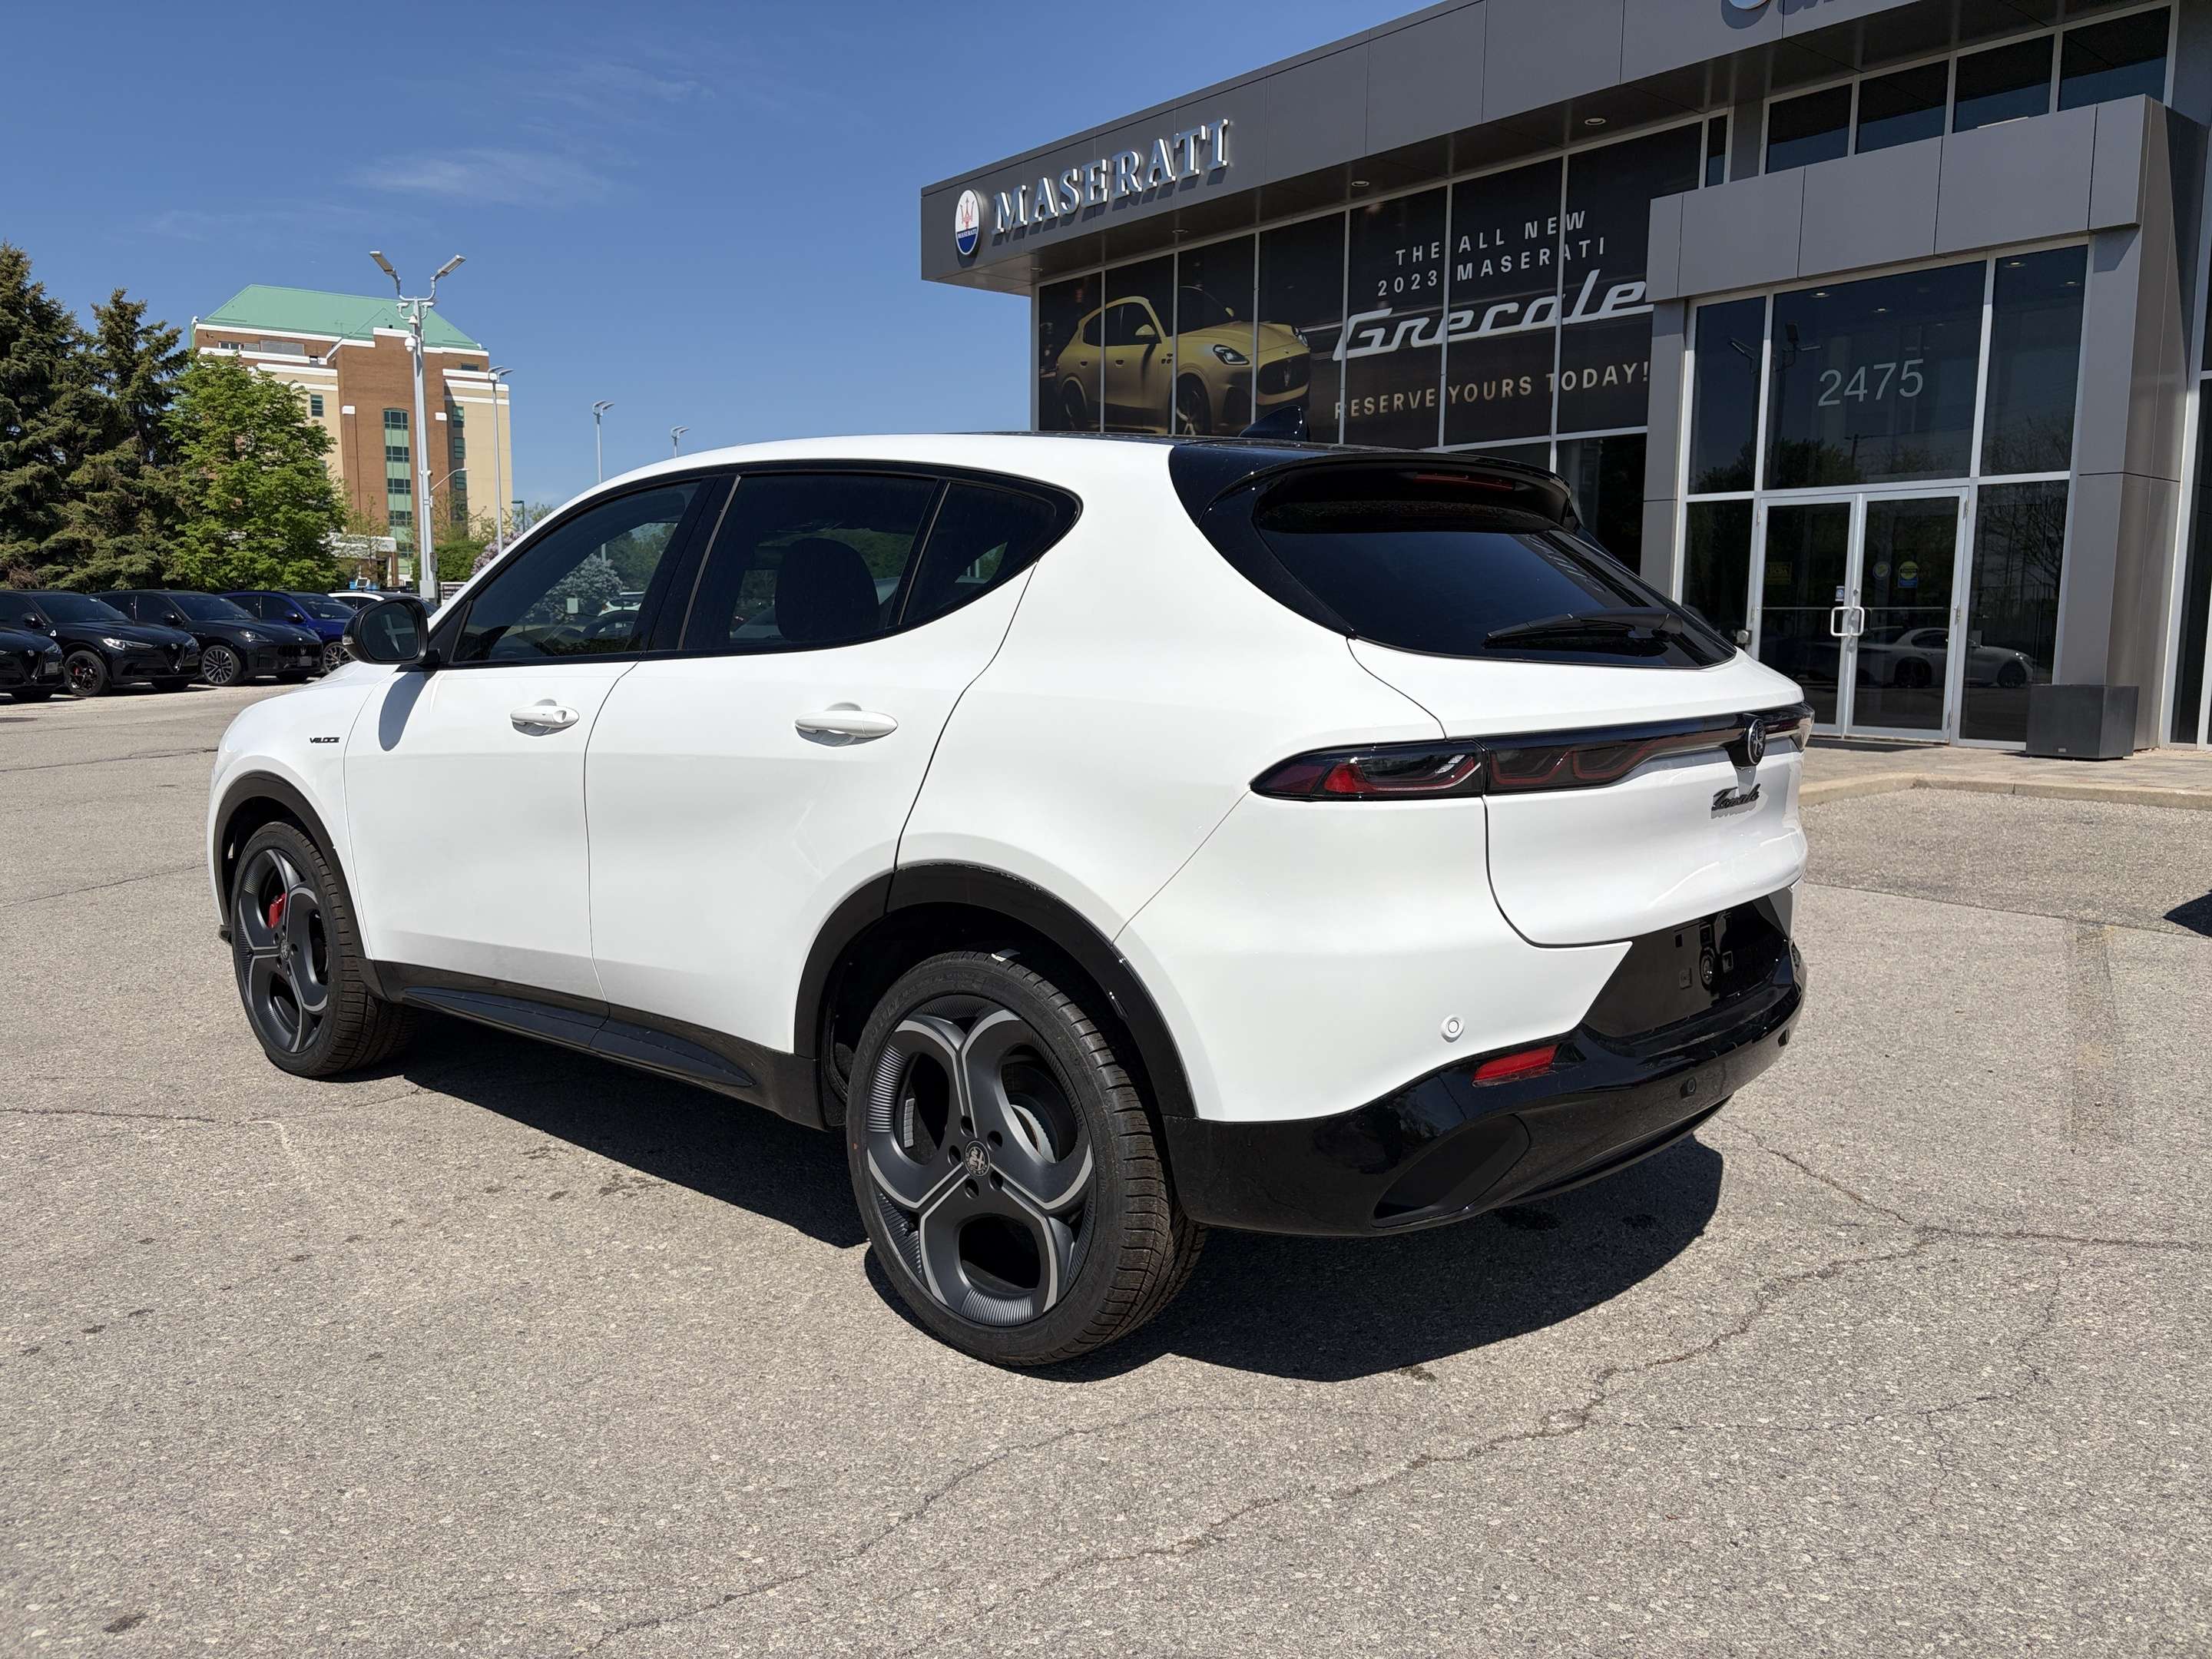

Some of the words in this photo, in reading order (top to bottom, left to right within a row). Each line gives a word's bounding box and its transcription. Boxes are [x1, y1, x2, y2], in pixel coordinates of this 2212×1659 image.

[992, 118, 1229, 233] MASERATI
[1377, 270, 1438, 296] 2023
[1457, 237, 1604, 281] MASERATI
[1395, 242, 1440, 266] THE
[1458, 229, 1505, 253] ALL
[1525, 210, 1585, 240] NEW
[1333, 269, 1654, 361] Grecale
[1334, 388, 1435, 420] RESERVE
[1447, 375, 1532, 405] YOURS
[1546, 361, 1649, 392] TODAY!
[1818, 359, 1924, 406] 2475
